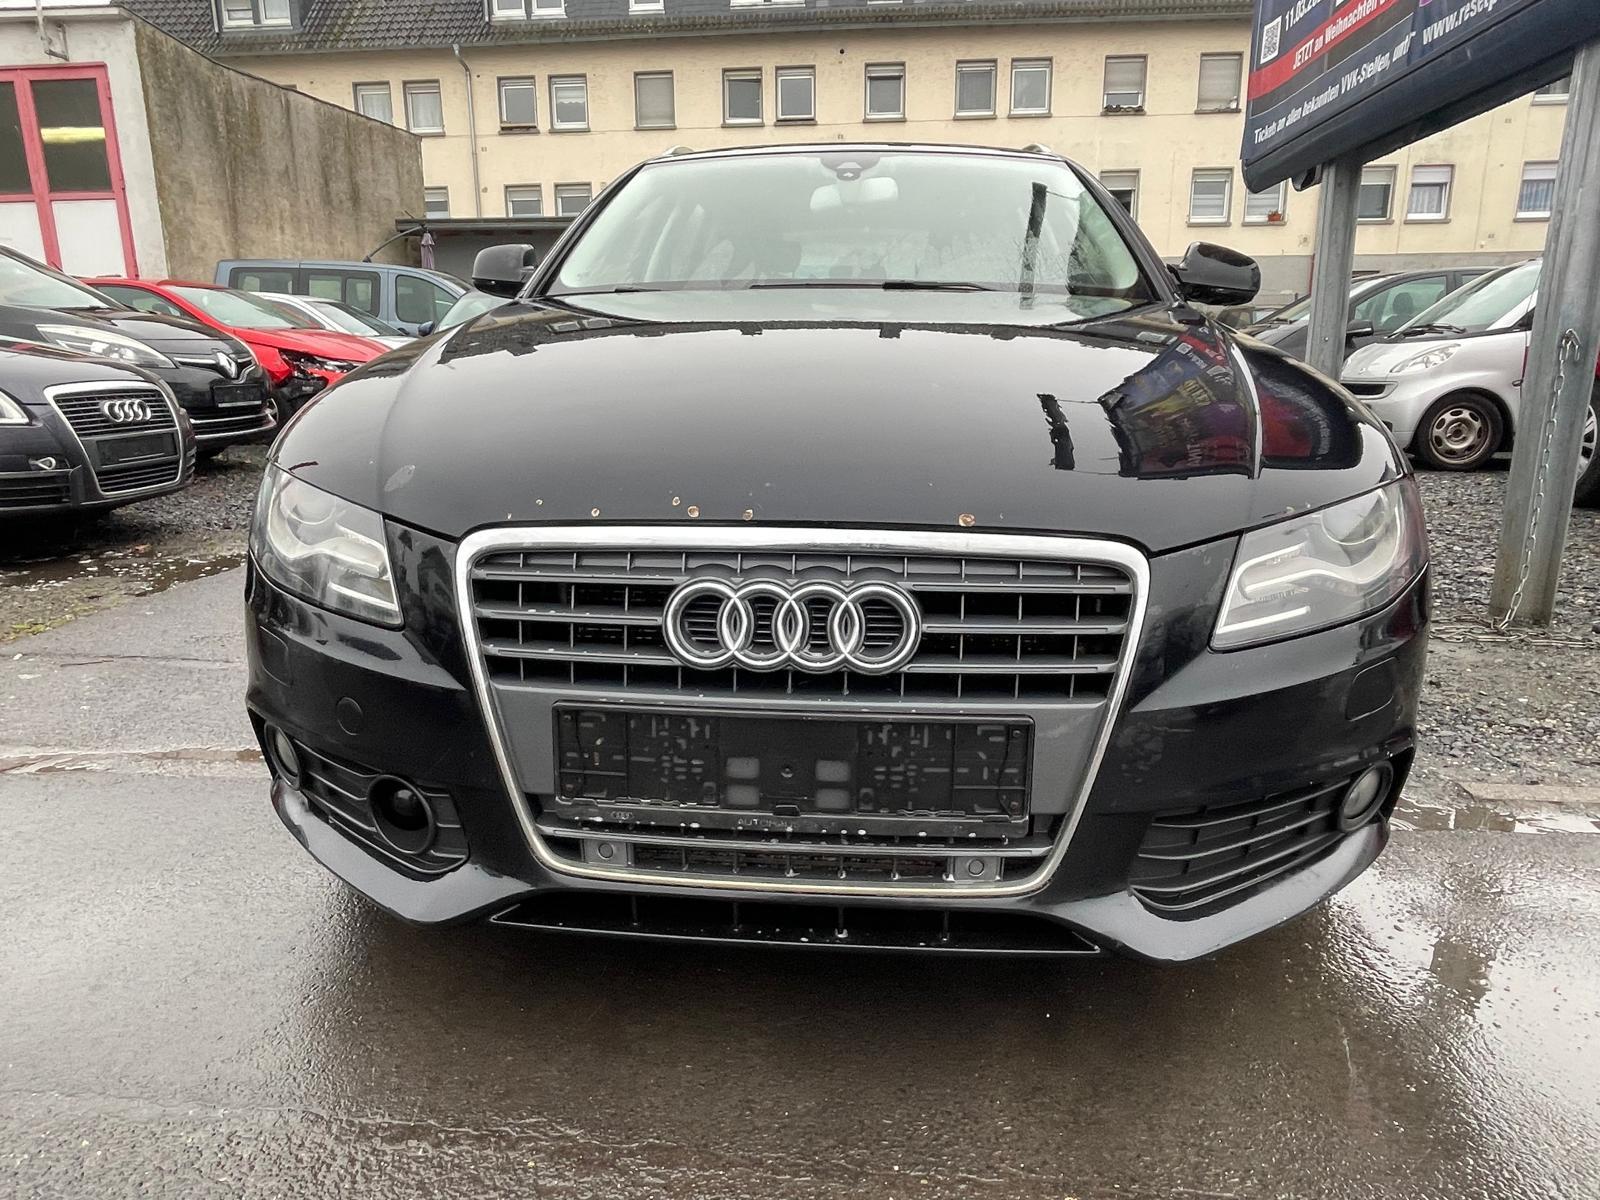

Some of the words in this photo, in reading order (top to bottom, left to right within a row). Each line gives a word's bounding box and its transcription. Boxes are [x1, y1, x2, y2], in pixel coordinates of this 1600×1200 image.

[1293, 38, 1315, 70] JETZT
[1254, 121, 1277, 144] Tickets
[1302, 84, 1340, 117] bekannten
